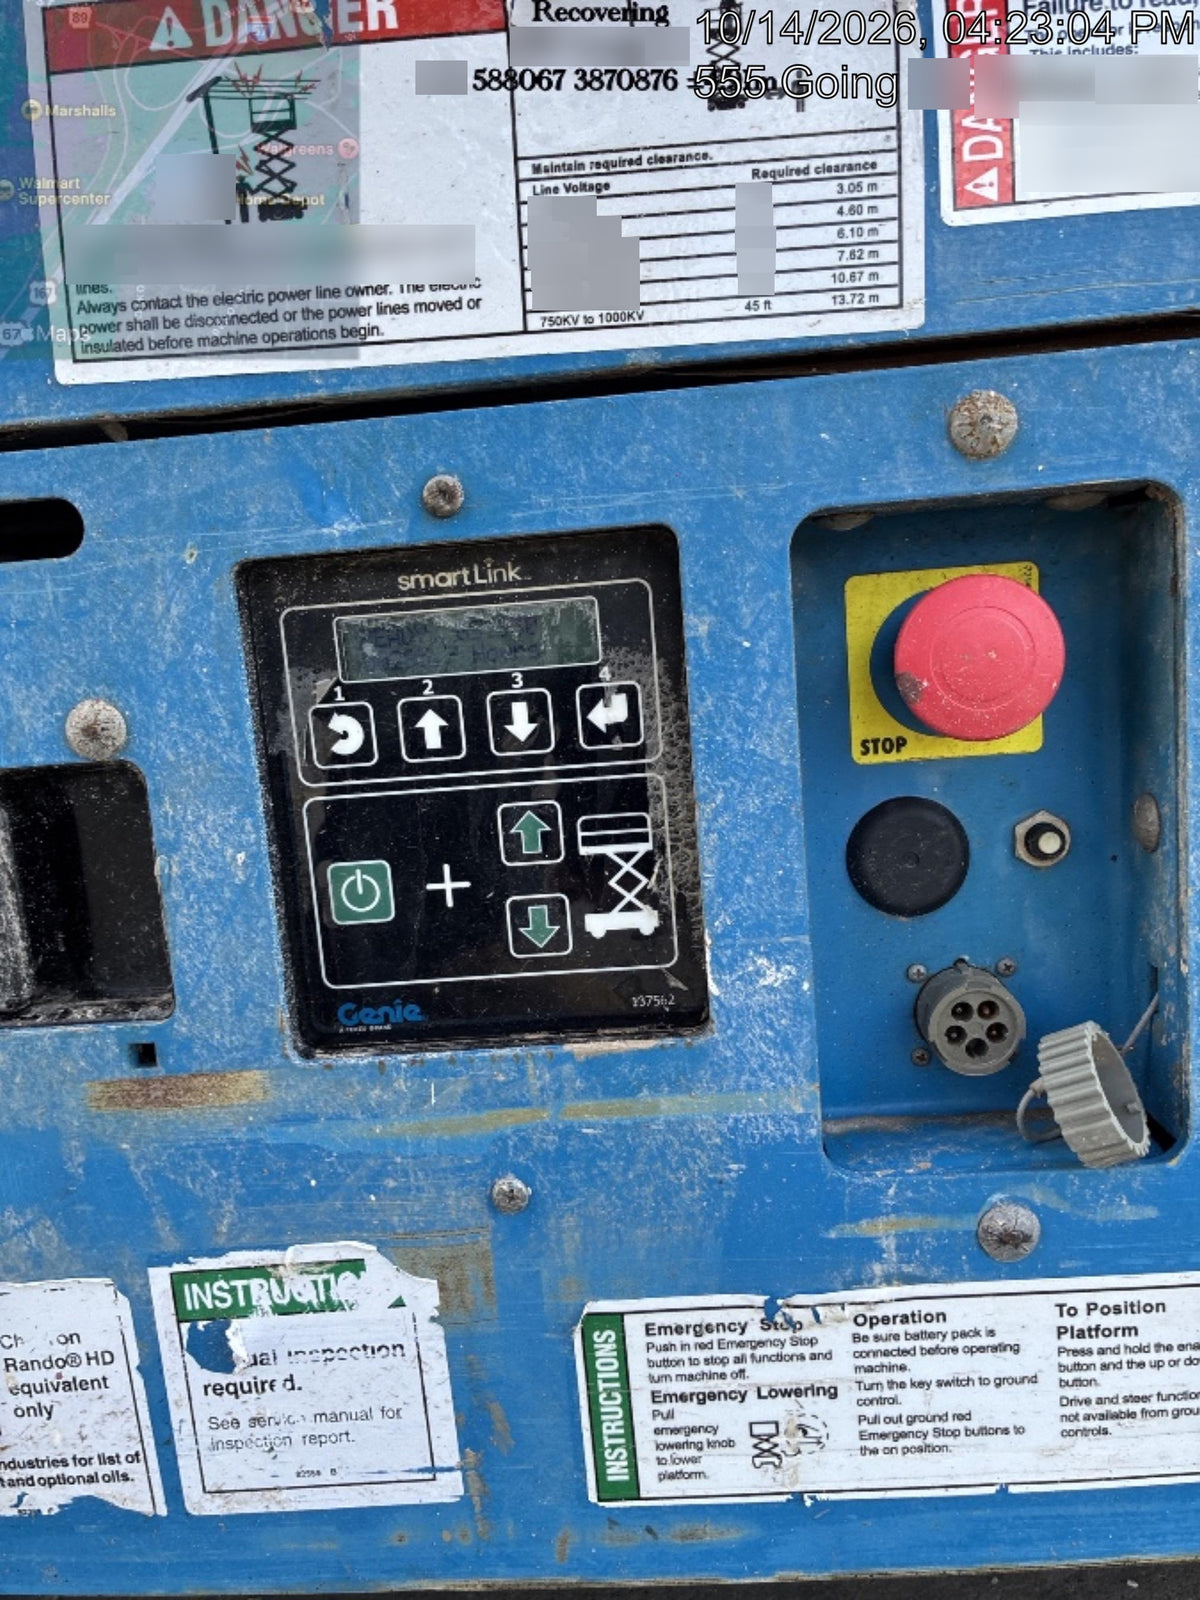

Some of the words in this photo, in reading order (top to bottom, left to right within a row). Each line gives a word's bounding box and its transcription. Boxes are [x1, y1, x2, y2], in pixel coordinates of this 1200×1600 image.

[531, 159, 586, 174] Maintain
[589, 155, 643, 173] required
[646, 151, 714, 165] clearance.
[752, 164, 810, 181] Required
[814, 160, 878, 175] clearance
[533, 184, 560, 196] Line
[563, 181, 611, 195] Voltage
[837, 182, 864, 195] 3.05
[837, 227, 863, 239] 6.10
[837, 249, 864, 262] 7.62
[831, 271, 864, 284] 10.67
[77, 300, 127, 316] Always
[131, 294, 183, 311] contact
[186, 293, 209, 308] the
[213, 289, 264, 306] electric
[268, 289, 311, 306] power
[316, 285, 341, 299] line
[345, 284, 393, 297] owner.
[745, 300, 760, 312] 45
[763, 299, 773, 310] ft
[832, 293, 864, 306] 13.72
[79, 321, 123, 338] power
[126, 316, 159, 331] shall
[162, 315, 181, 330] be
[184, 308, 279, 328] disconnected
[283, 310, 298, 322] or
[302, 307, 324, 320] the
[328, 305, 373, 321] power
[376, 302, 410, 316] lines
[414, 298, 463, 313] moved
[466, 297, 482, 310] or
[540, 314, 580, 328] 750KV
[584, 313, 594, 325] to
[598, 310, 645, 324] 1000KV
[80, 338, 145, 354] insulated
[148, 335, 193, 351] before
[197, 331, 258, 347] machine
[262, 328, 337, 346] operations
[341, 323, 385, 341] begin.
[511, 672, 524, 688] 3
[598, 665, 611, 682] 4
[334, 685, 346, 702] 1
[422, 679, 435, 695] 2
[860, 736, 908, 756] STOP
[336, 998, 426, 1027] Genie
[1055, 1303, 1078, 1318] To
[1086, 1300, 1166, 1317] Position
[853, 1309, 947, 1329] Operation
[645, 1320, 748, 1338] Emergency
[852, 1332, 870, 1344] Be
[873, 1333, 901, 1343] sure
[904, 1330, 948, 1344] battery
[951, 1328, 982, 1342] pack
[1056, 1324, 1139, 1340] Platform
[646, 1340, 677, 1353] Push
[680, 1340, 692, 1352] in
[695, 1338, 714, 1350] red
[717, 1336, 786, 1353] Emergency
[790, 1334, 819, 1349] Stop
[853, 1346, 916, 1359] connected
[919, 1345, 959, 1357] before
[962, 1341, 1021, 1356] operating
[1057, 1346, 1095, 1358] Press
[1097, 1344, 1121, 1356] and
[1124, 1342, 1151, 1355] hold
[1154, 1341, 1174, 1353] the
[85, 1350, 115, 1366] HD
[647, 1357, 685, 1370] button
[687, 1356, 700, 1368] to
[703, 1354, 730, 1369] stop
[750, 1350, 806, 1365] functions
[808, 1349, 833, 1362] and
[1058, 1362, 1096, 1374] button
[1100, 1359, 1123, 1371] and
[1126, 1357, 1146, 1370] the
[1150, 1358, 1165, 1371] up
[1168, 1357, 1181, 1368] or
[648, 1371, 673, 1385] turn
[675, 1369, 729, 1383] machine
[731, 1367, 750, 1381] off.
[854, 1362, 911, 1374] machine.
[8, 1375, 110, 1399] equivalent
[855, 1379, 885, 1392] Turn
[887, 1378, 906, 1390] the
[909, 1377, 933, 1391] key
[935, 1375, 975, 1388] switch
[978, 1375, 991, 1386] to
[994, 1373, 1039, 1389] ground
[1059, 1377, 1100, 1389] button.
[650, 1388, 748, 1406] Emergency
[756, 1384, 839, 1401] Lowering
[856, 1395, 902, 1407] control.
[1059, 1395, 1092, 1408] Drive
[1095, 1393, 1119, 1406] and
[1122, 1393, 1153, 1404] steer
[13, 1401, 54, 1421] only
[593, 1329, 631, 1482] INSTRUCTIONS
[208, 1415, 241, 1430] See
[313, 1406, 374, 1424] manual
[381, 1405, 402, 1420] for
[652, 1408, 675, 1421] Pull
[858, 1414, 881, 1426] Pull
[883, 1413, 903, 1425] out
[906, 1411, 949, 1427] ground
[952, 1410, 972, 1422] red
[1060, 1412, 1080, 1423] not
[1082, 1409, 1137, 1422] available
[1141, 1407, 1169, 1419] from
[302, 1430, 356, 1448] report.
[653, 1423, 719, 1438] emergency
[859, 1428, 929, 1442] Emergency
[932, 1427, 961, 1439] Stop
[964, 1425, 1010, 1438] buttons
[1013, 1424, 1026, 1436] to
[1061, 1426, 1112, 1438] controls.
[655, 1440, 704, 1453] lowering
[706, 1437, 736, 1450] knob
[901, 1443, 952, 1457] position.
[71, 1453, 94, 1468] for
[97, 1451, 122, 1466] list
[125, 1450, 141, 1464] of
[670, 1453, 702, 1465] lower
[7, 1474, 36, 1488] and
[36, 1471, 100, 1489] optional
[101, 1469, 135, 1484] oils.
